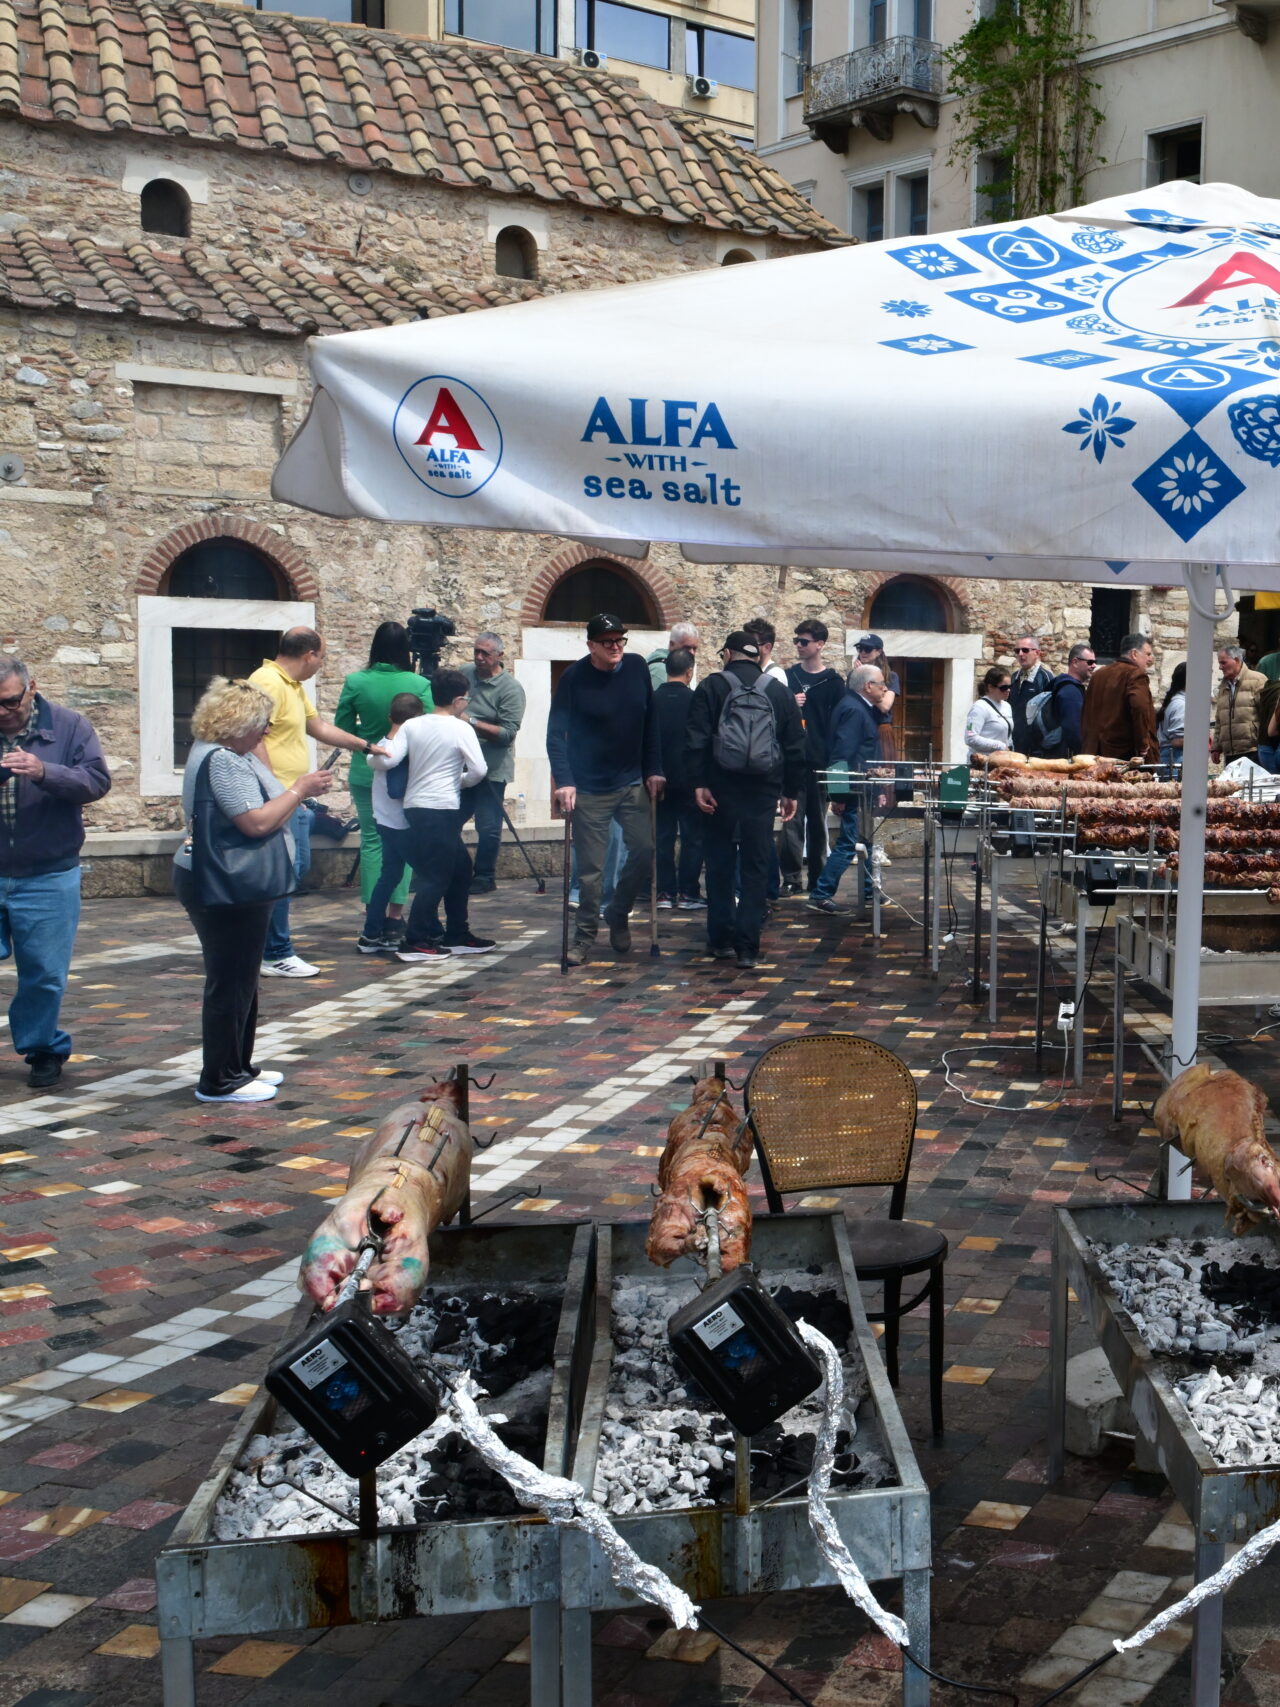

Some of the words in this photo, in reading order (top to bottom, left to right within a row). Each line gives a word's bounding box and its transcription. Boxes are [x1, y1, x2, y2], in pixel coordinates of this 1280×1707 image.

[412, 387, 487, 451] A
[580, 395, 739, 450] ALFA
[426, 447, 471, 464] ALFA
[623, 452, 687, 472] WITH
[427, 469, 447, 478] sea
[448, 468, 472, 479] salt
[583, 474, 653, 500] sea
[661, 472, 742, 507] salt
[703, 1311, 723, 1328] AERO
[301, 1348, 322, 1367] AERO
